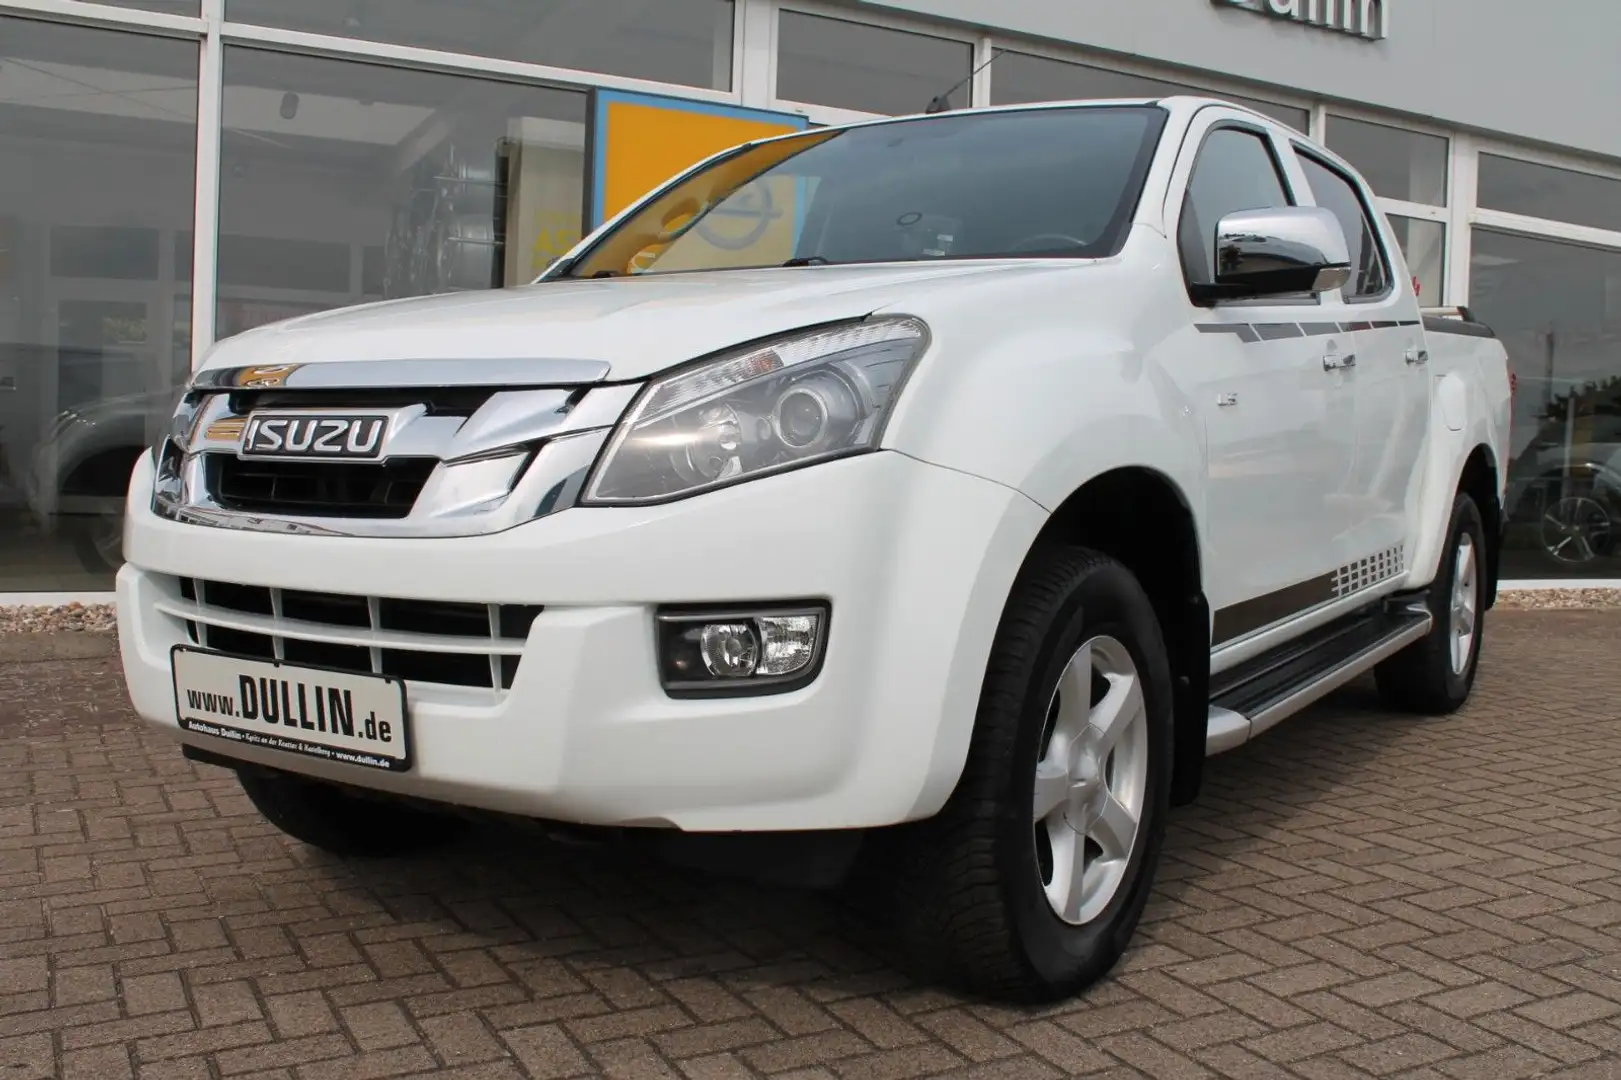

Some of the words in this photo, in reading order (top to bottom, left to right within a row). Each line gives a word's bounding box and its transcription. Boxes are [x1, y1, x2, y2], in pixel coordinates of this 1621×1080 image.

[246, 418, 383, 452] ISUZU
[186, 673, 393, 743] www.DULLIN.de
[188, 720, 220, 736] Autohaus
[221, 727, 242, 741] Dullin
[336, 751, 390, 768] www.dullin.de
